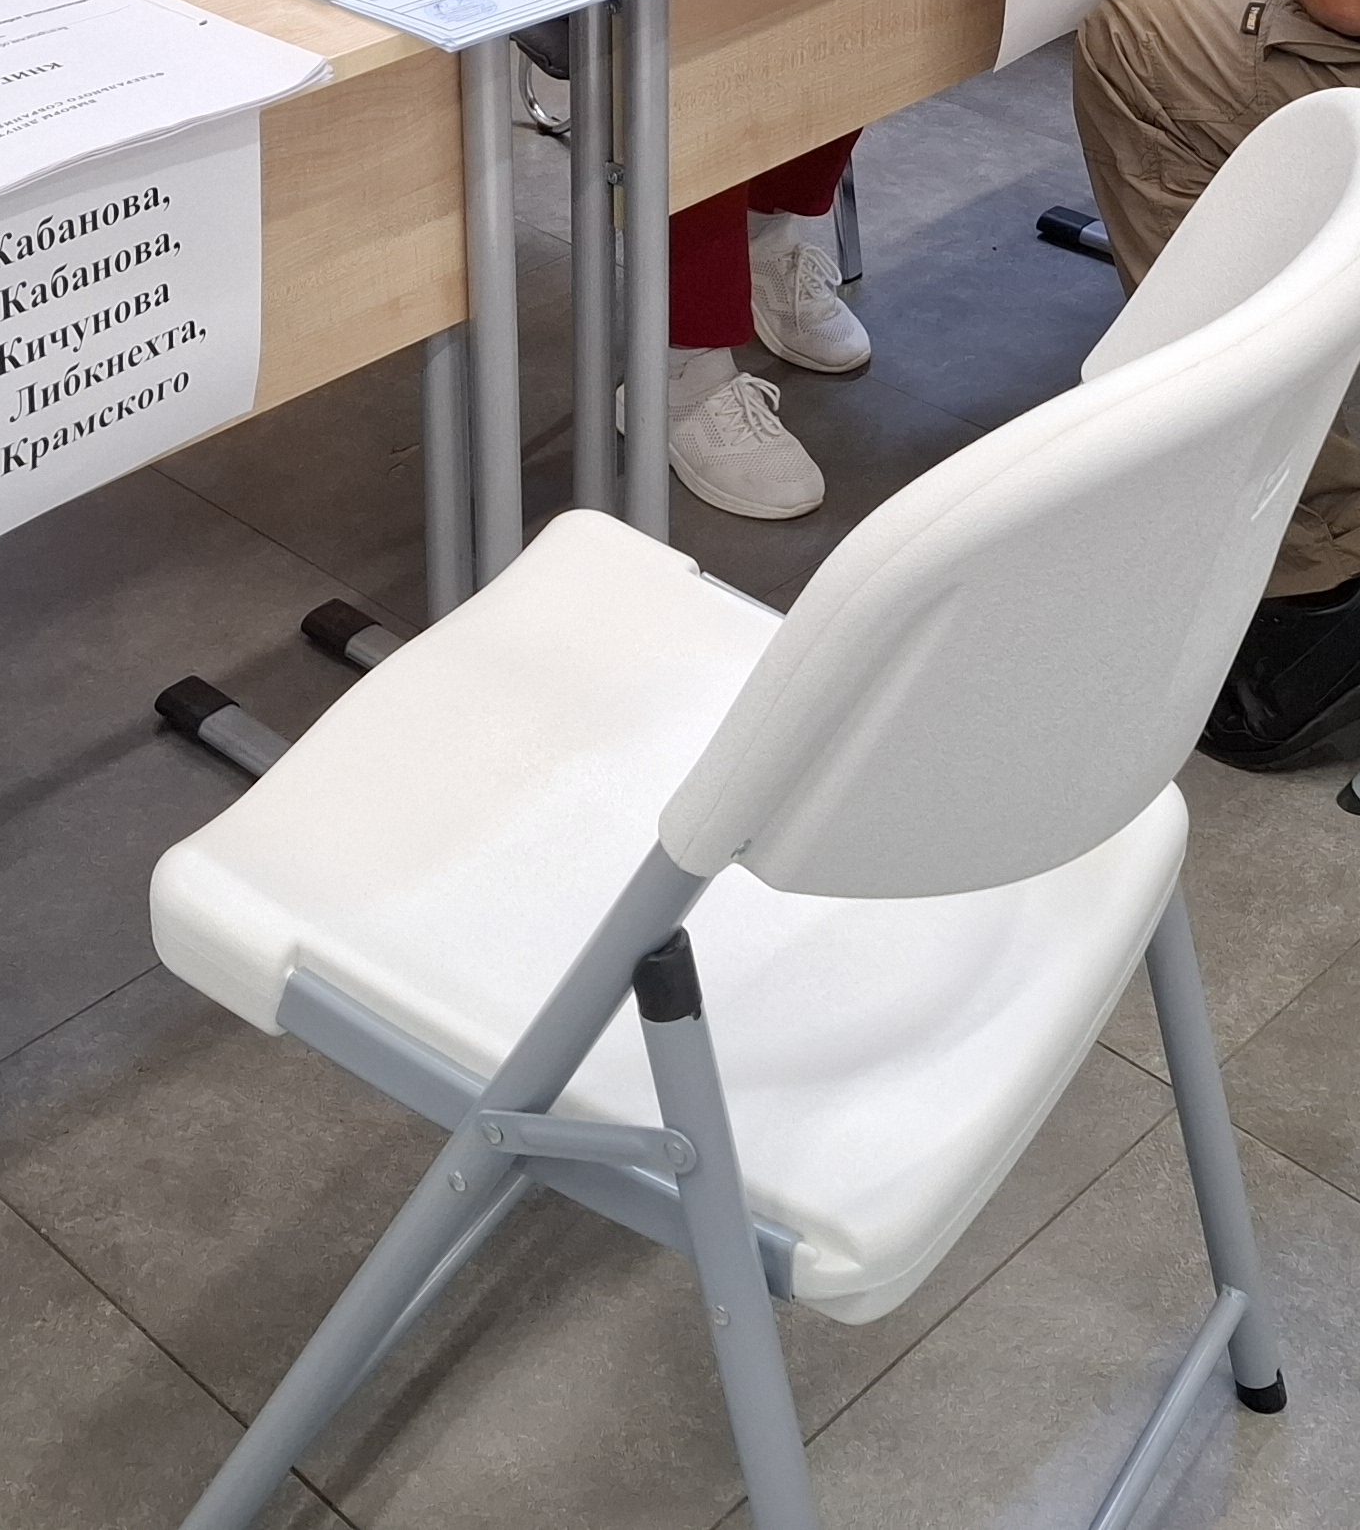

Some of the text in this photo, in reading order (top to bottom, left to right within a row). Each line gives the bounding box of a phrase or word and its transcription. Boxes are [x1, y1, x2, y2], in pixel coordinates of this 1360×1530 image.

[41, 98, 97, 120] ВЫБОРЫ
[66, 71, 165, 103] ФЕДЕРАЛЬНОГО
[0, 230, 183, 323] Кабанова,
[9, 318, 208, 424] Либкнехта,
[0, 369, 191, 479] Крамского
